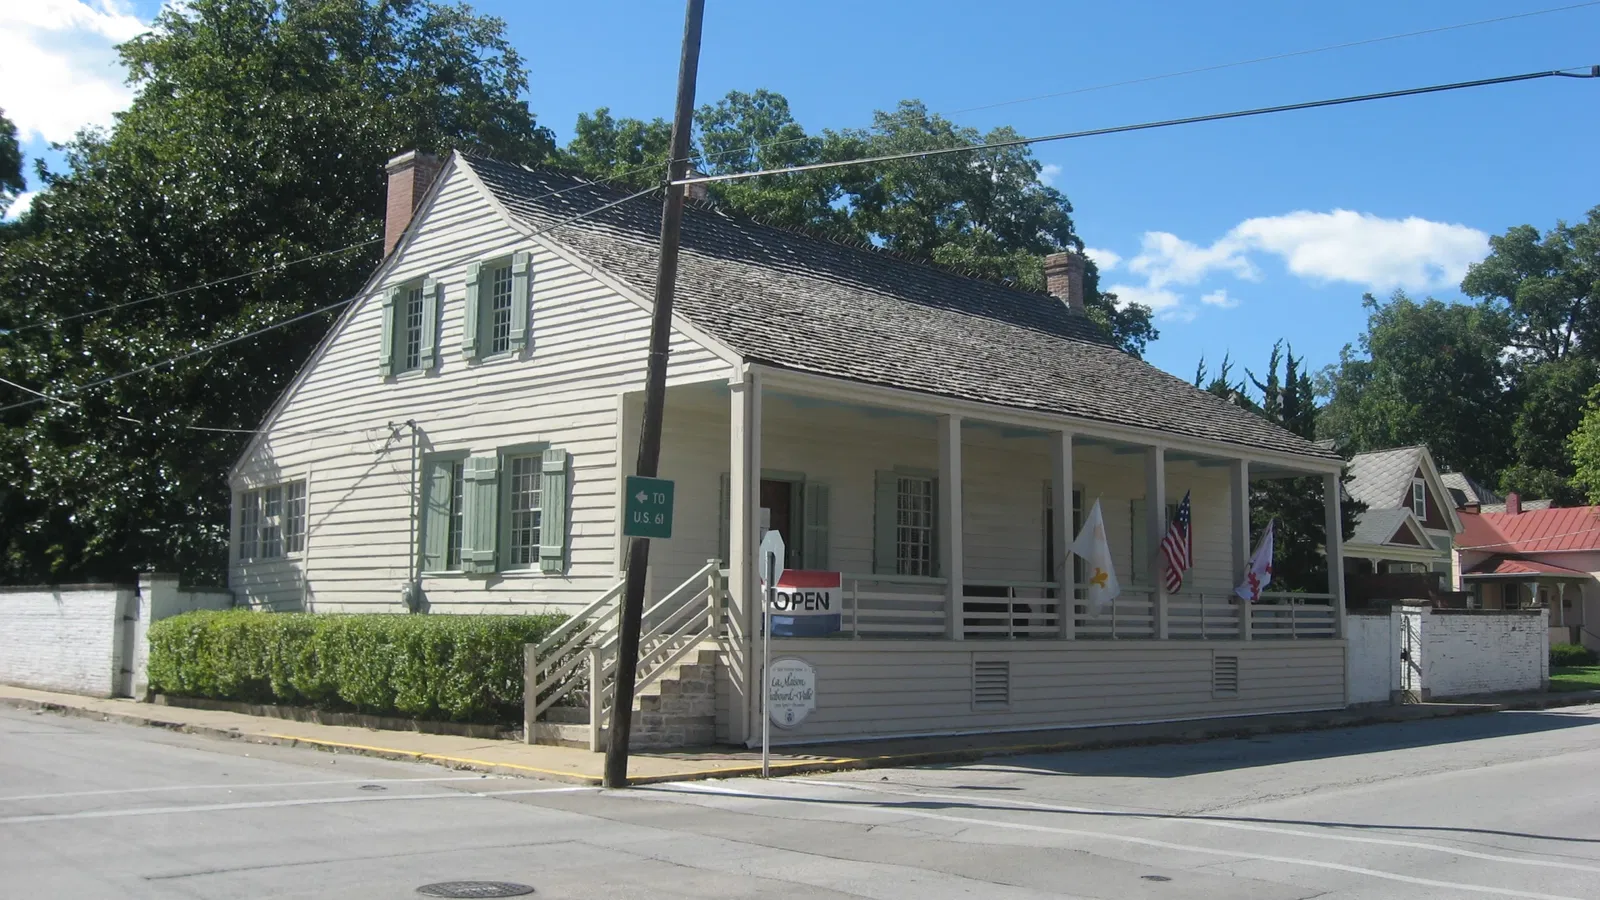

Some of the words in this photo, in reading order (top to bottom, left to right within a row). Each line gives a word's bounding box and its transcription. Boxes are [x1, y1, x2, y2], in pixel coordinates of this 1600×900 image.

[652, 492, 665, 505] TO
[633, 511, 651, 524] U.S.
[654, 513, 664, 525] 61
[773, 591, 830, 611] OPEN
[771, 676, 783, 688] La
[784, 672, 806, 687] Maison
